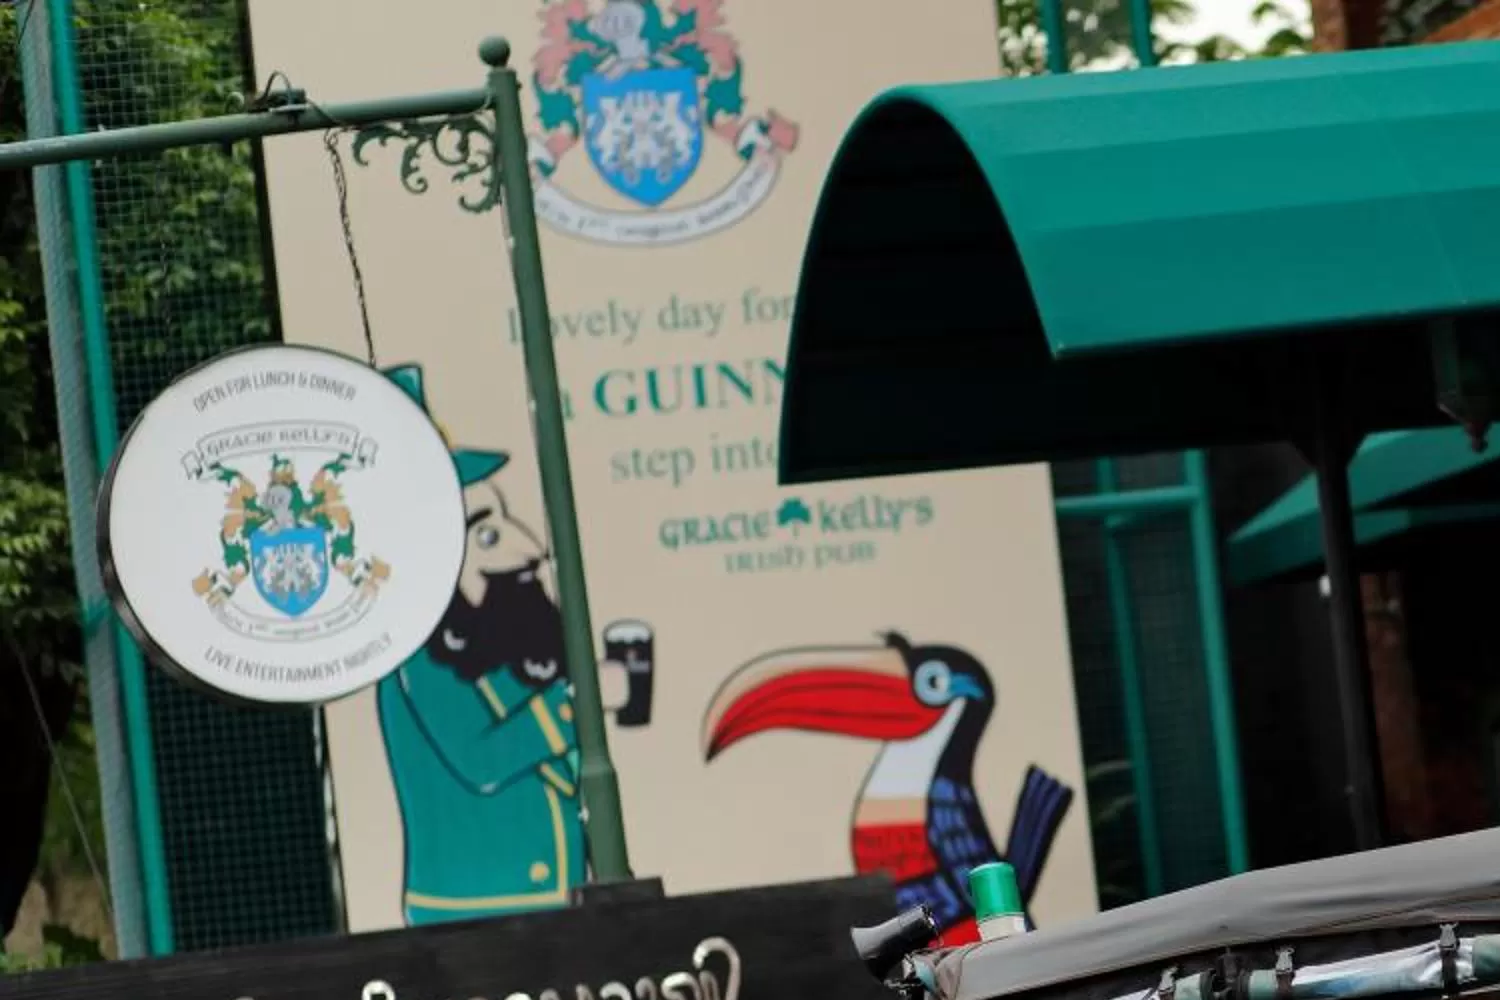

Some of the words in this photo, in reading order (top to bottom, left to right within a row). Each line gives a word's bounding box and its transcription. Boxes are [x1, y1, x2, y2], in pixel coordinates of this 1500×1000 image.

[657, 294, 724, 338] day
[741, 286, 796, 324] for
[193, 386, 227, 413] OPEN
[225, 375, 253, 397] FOR
[253, 371, 296, 391] LUNCH
[309, 373, 357, 401] DINNER
[610, 446, 696, 487] step
[204, 645, 232, 670] LIVE
[235, 658, 341, 683] ENTERTAINMENT
